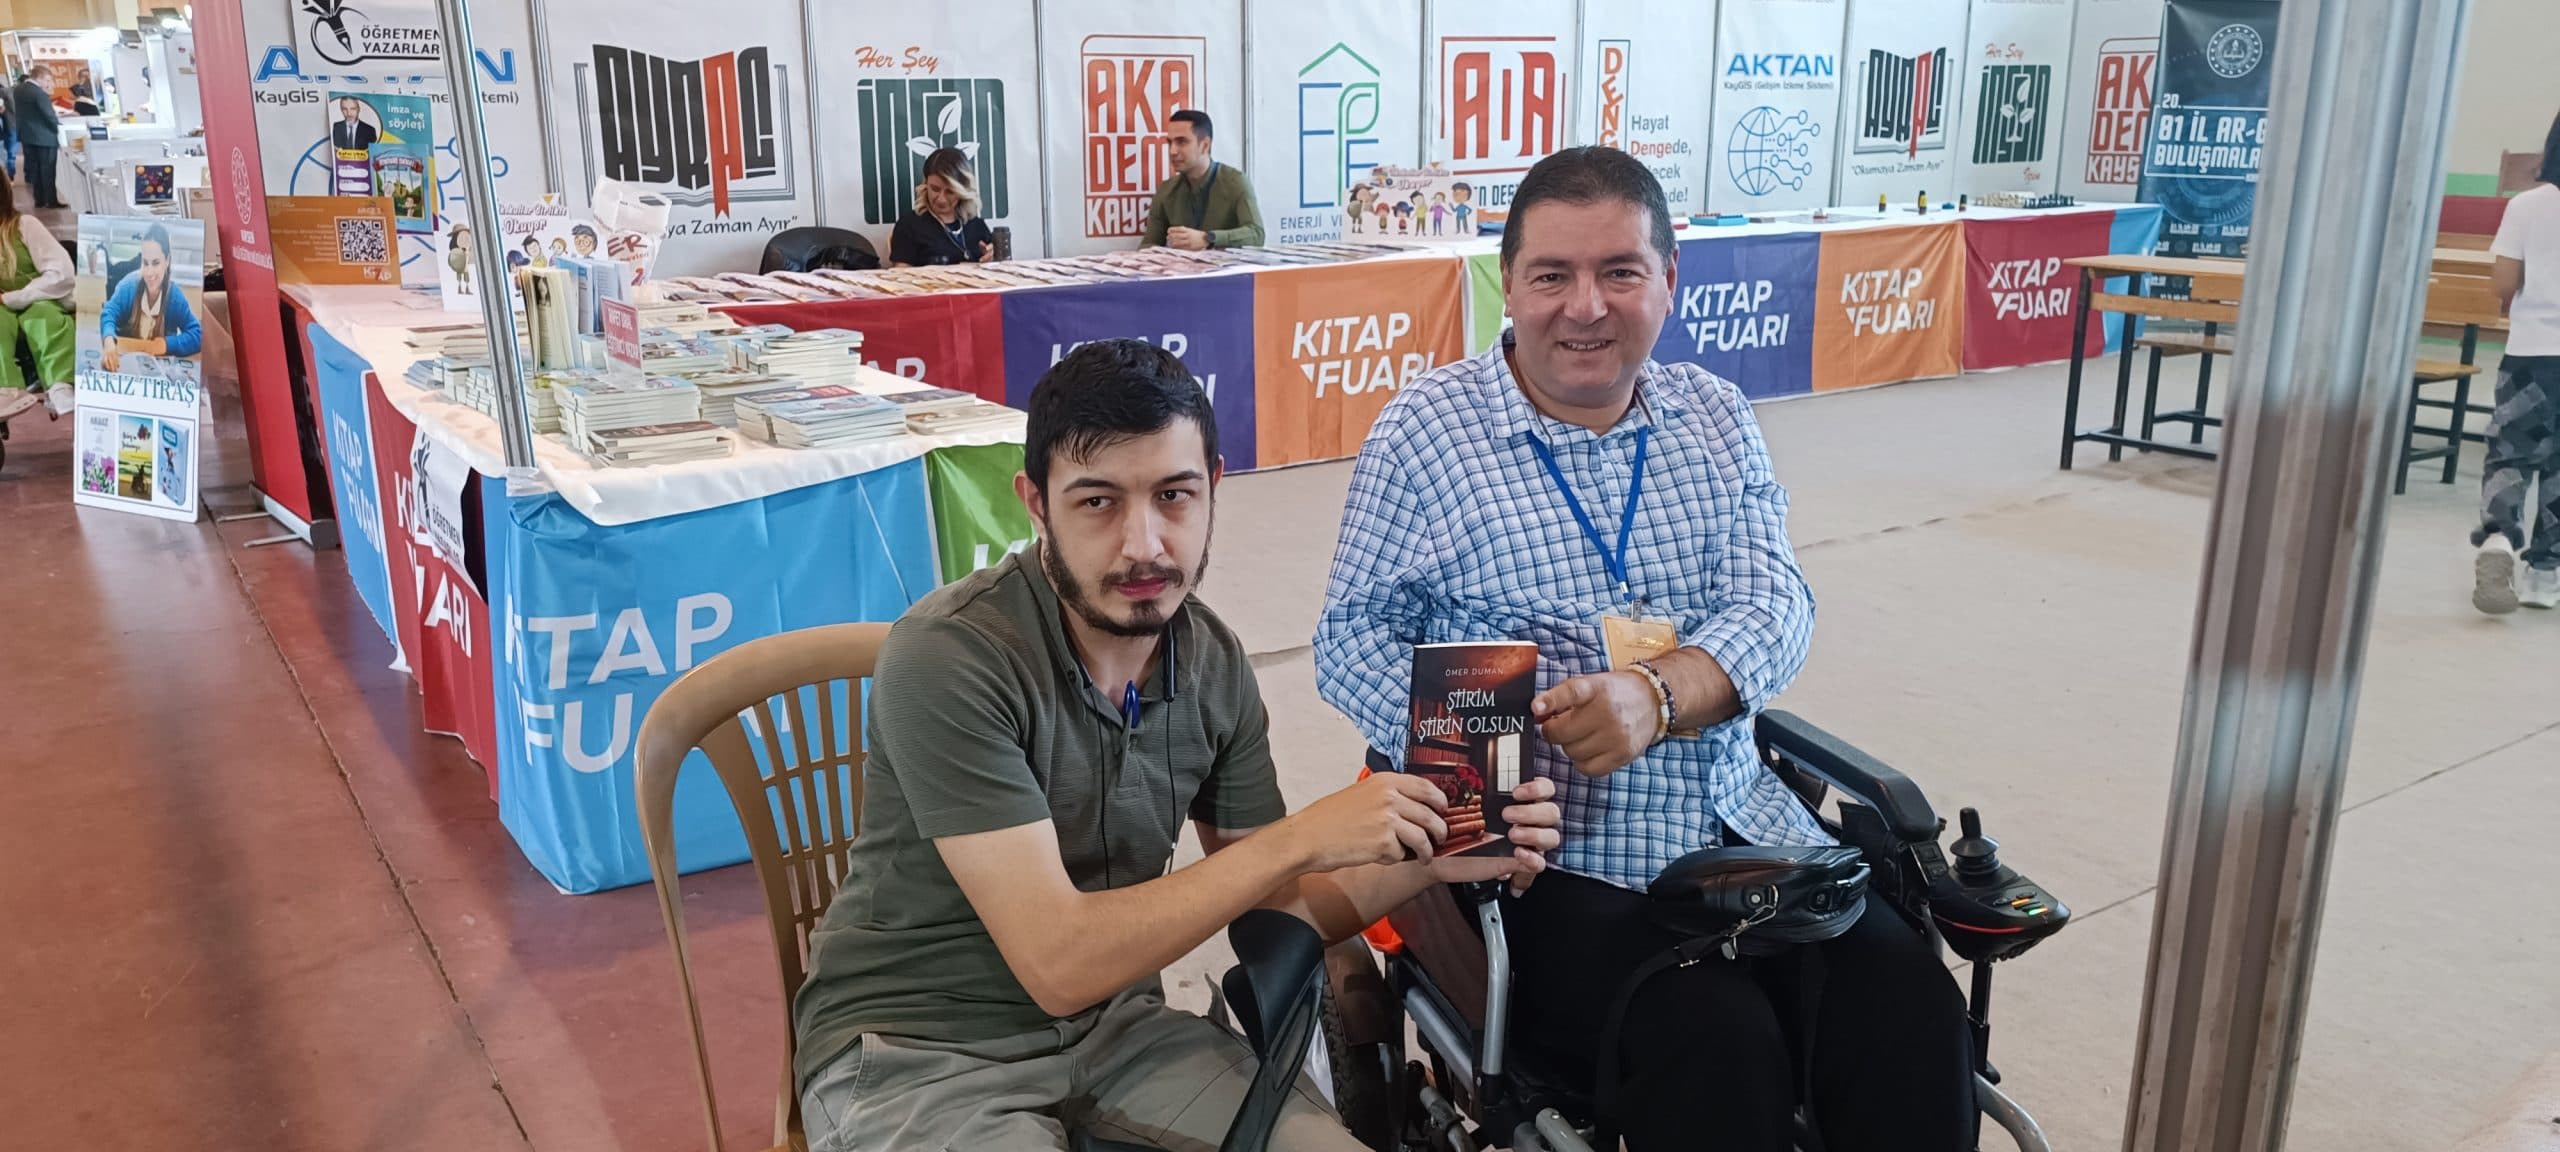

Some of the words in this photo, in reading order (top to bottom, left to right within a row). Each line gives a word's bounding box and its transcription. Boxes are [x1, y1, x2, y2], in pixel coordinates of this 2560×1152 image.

[855, 46, 894, 69] Her
[901, 46, 940, 75] Şey
[1727, 54, 1834, 77] AKTAN
[387, 104, 410, 114] İmza
[412, 111, 425, 119] ve
[2162, 93, 2182, 108] 20.
[388, 117, 426, 131] söyleşi
[1631, 114, 1670, 136] Hayat
[2159, 114, 2184, 141] 81
[2189, 111, 2208, 142] İL
[2216, 117, 2269, 144] AR-G
[1630, 139, 1692, 159] Dengede,
[691, 218, 752, 235] Zaman
[1280, 213, 1322, 230] ENERJİ
[1840, 267, 1925, 304] KİTAP
[1680, 279, 1774, 320] KİTAP
[1996, 288, 2072, 321] FUARI
[1852, 299, 1936, 337] FUARI
[1292, 312, 1411, 360] KİTAP
[1697, 313, 1790, 354] FUARI
[1445, 667, 1470, 677] ÖMER
[1472, 667, 1504, 676] DUMAN
[1466, 715, 1526, 735] OLSUN
